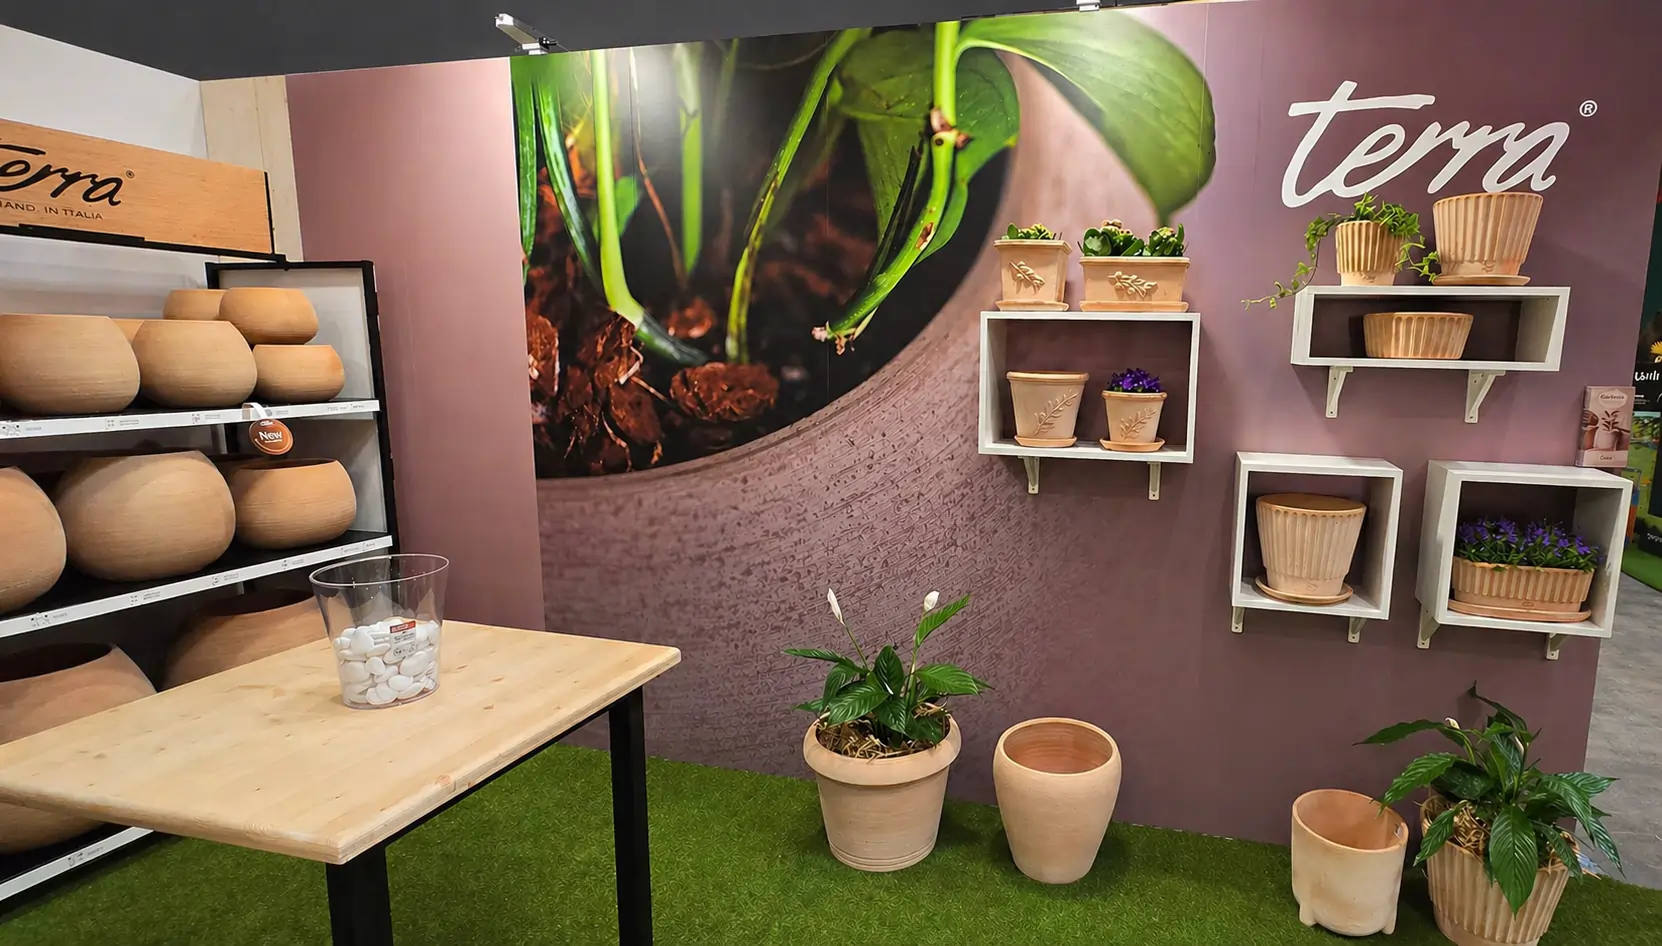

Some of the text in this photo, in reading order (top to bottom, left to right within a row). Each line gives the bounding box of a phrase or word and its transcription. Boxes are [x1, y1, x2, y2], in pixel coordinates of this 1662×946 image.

[1281, 80, 1570, 208] terra
[44, 206, 59, 215] IN
[258, 431, 283, 441] New
